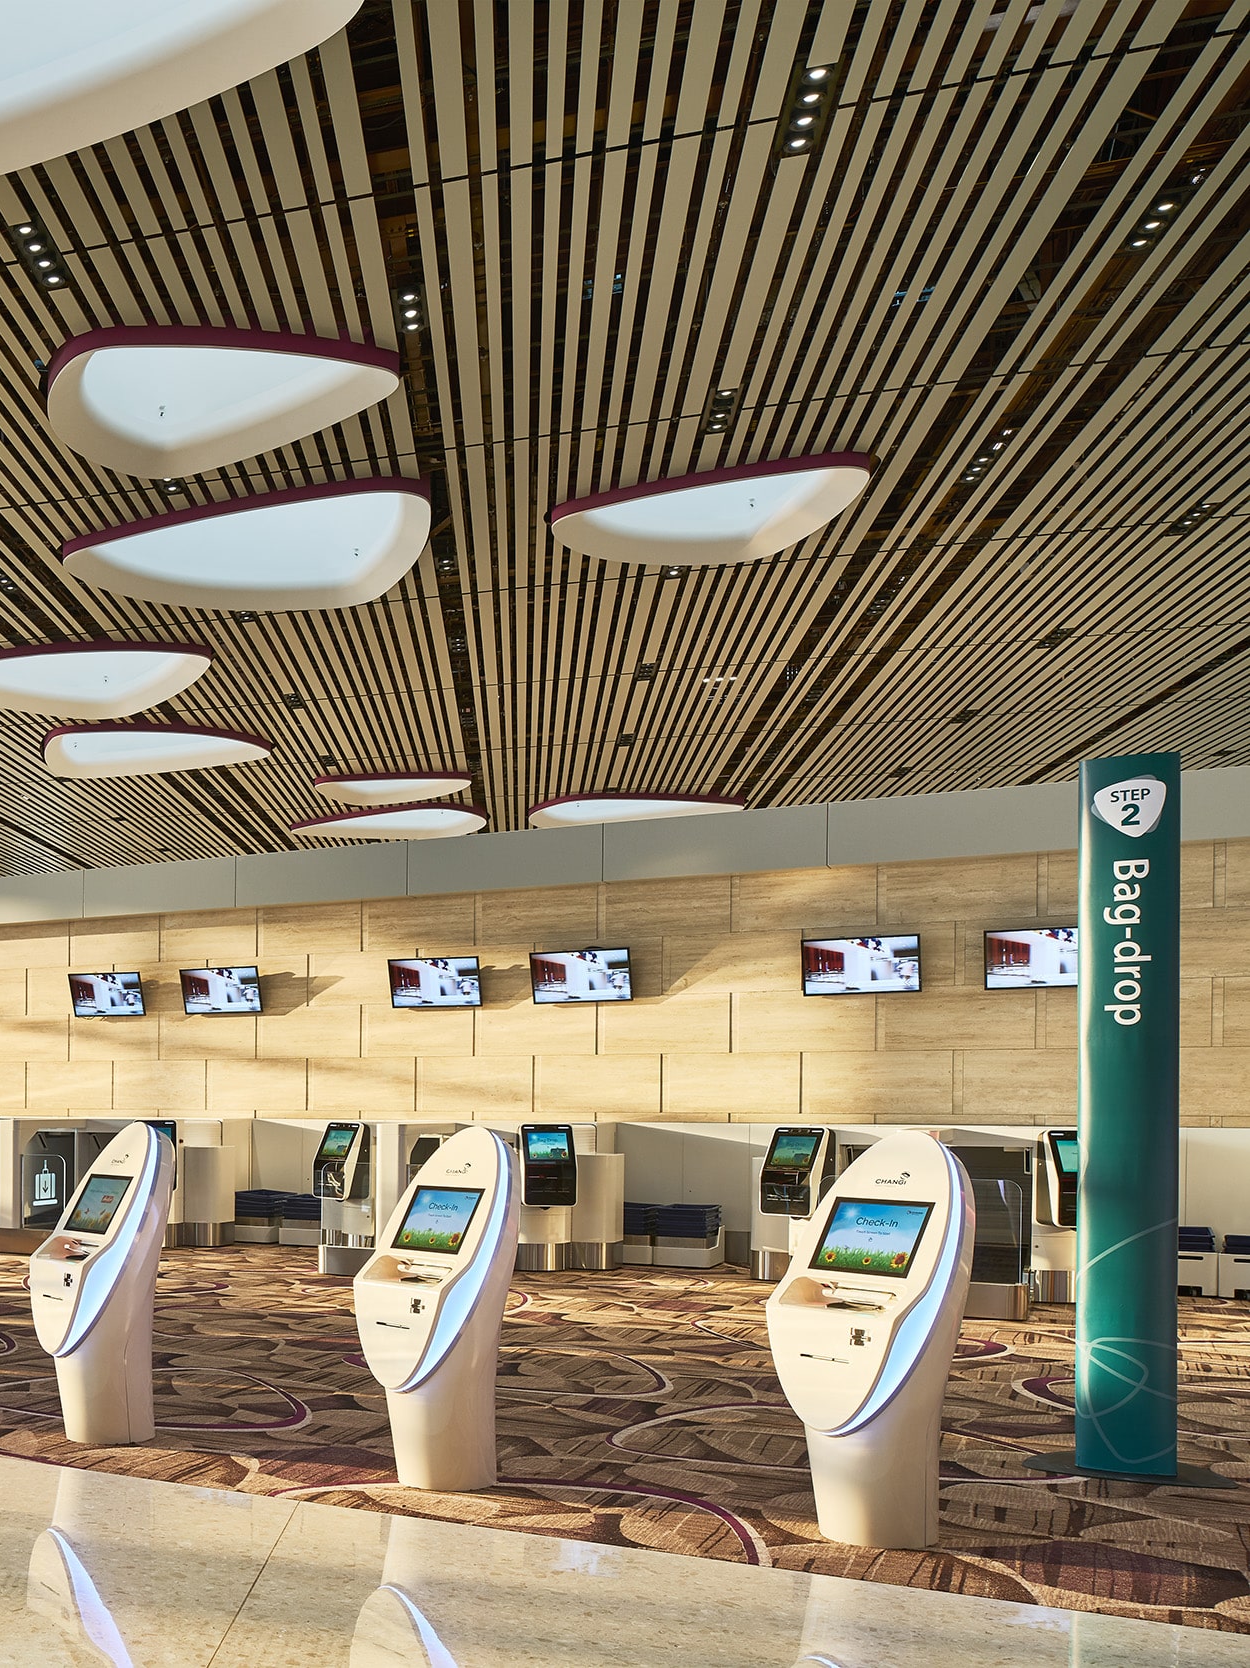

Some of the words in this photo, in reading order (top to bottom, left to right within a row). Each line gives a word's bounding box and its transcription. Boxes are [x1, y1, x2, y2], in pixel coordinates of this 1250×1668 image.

[1110, 788, 1151, 803] STEP
[1121, 803, 1141, 826] 2
[1103, 858, 1152, 1026] Bag-drop
[428, 1202, 459, 1211] Check-In
[855, 1216, 899, 1228] Check-In
